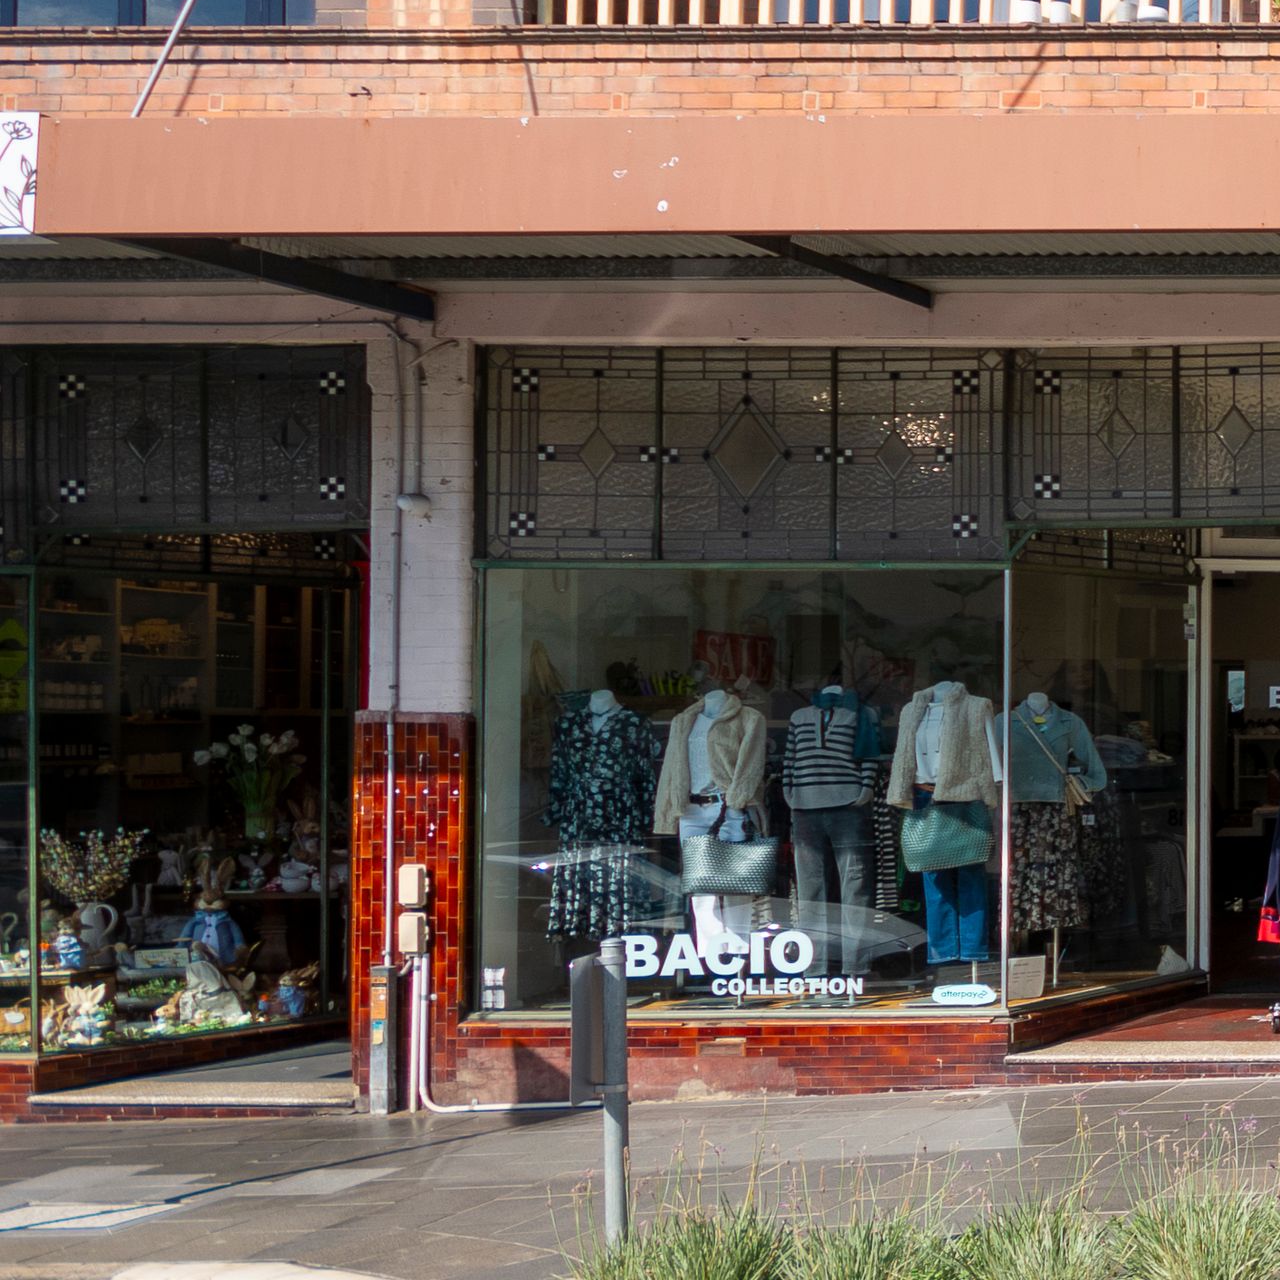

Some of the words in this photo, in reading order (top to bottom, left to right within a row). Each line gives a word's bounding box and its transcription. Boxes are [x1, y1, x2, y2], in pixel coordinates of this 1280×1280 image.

[706, 634, 770, 682] SALE
[620, 930, 815, 978] BACIO
[711, 977, 863, 996] COLLECTION
[940, 990, 978, 999] afterpay
